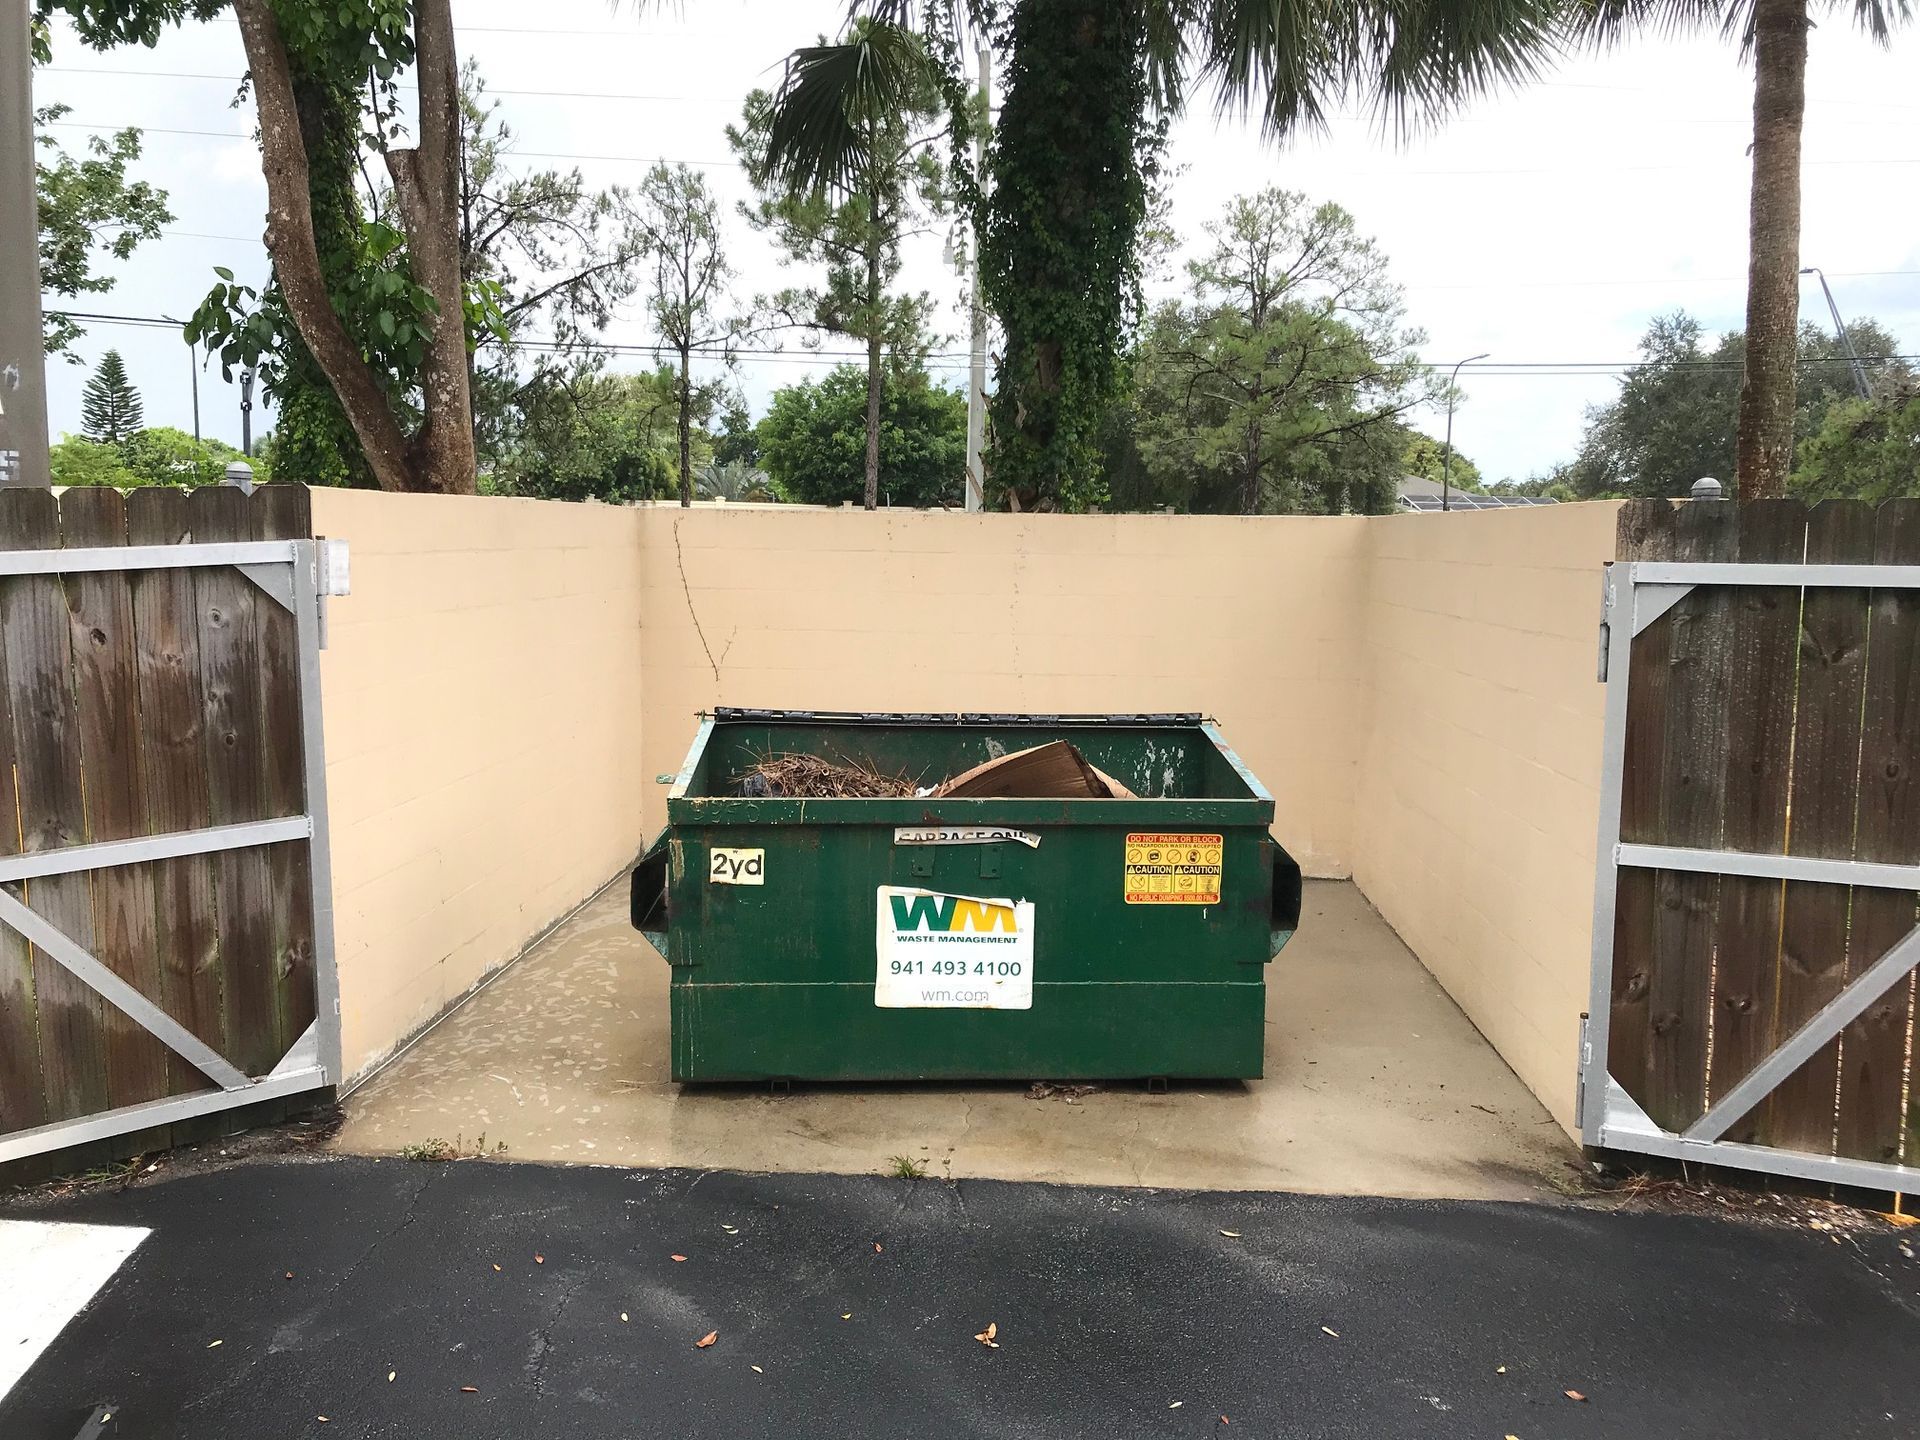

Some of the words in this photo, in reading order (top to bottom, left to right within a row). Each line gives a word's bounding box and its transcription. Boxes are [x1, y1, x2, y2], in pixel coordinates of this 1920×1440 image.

[713, 853, 762, 879] 2yd
[1135, 865, 1172, 874] CAUTION
[1183, 866, 1220, 874] CAUTION
[890, 896, 1017, 933] WM
[897, 935, 934, 943] WASTE
[938, 936, 1018, 944] MANAGEMENT
[890, 960, 924, 975] 941
[932, 961, 967, 976] 493
[973, 961, 1022, 976] 4100
[921, 990, 989, 1002] wm.com
